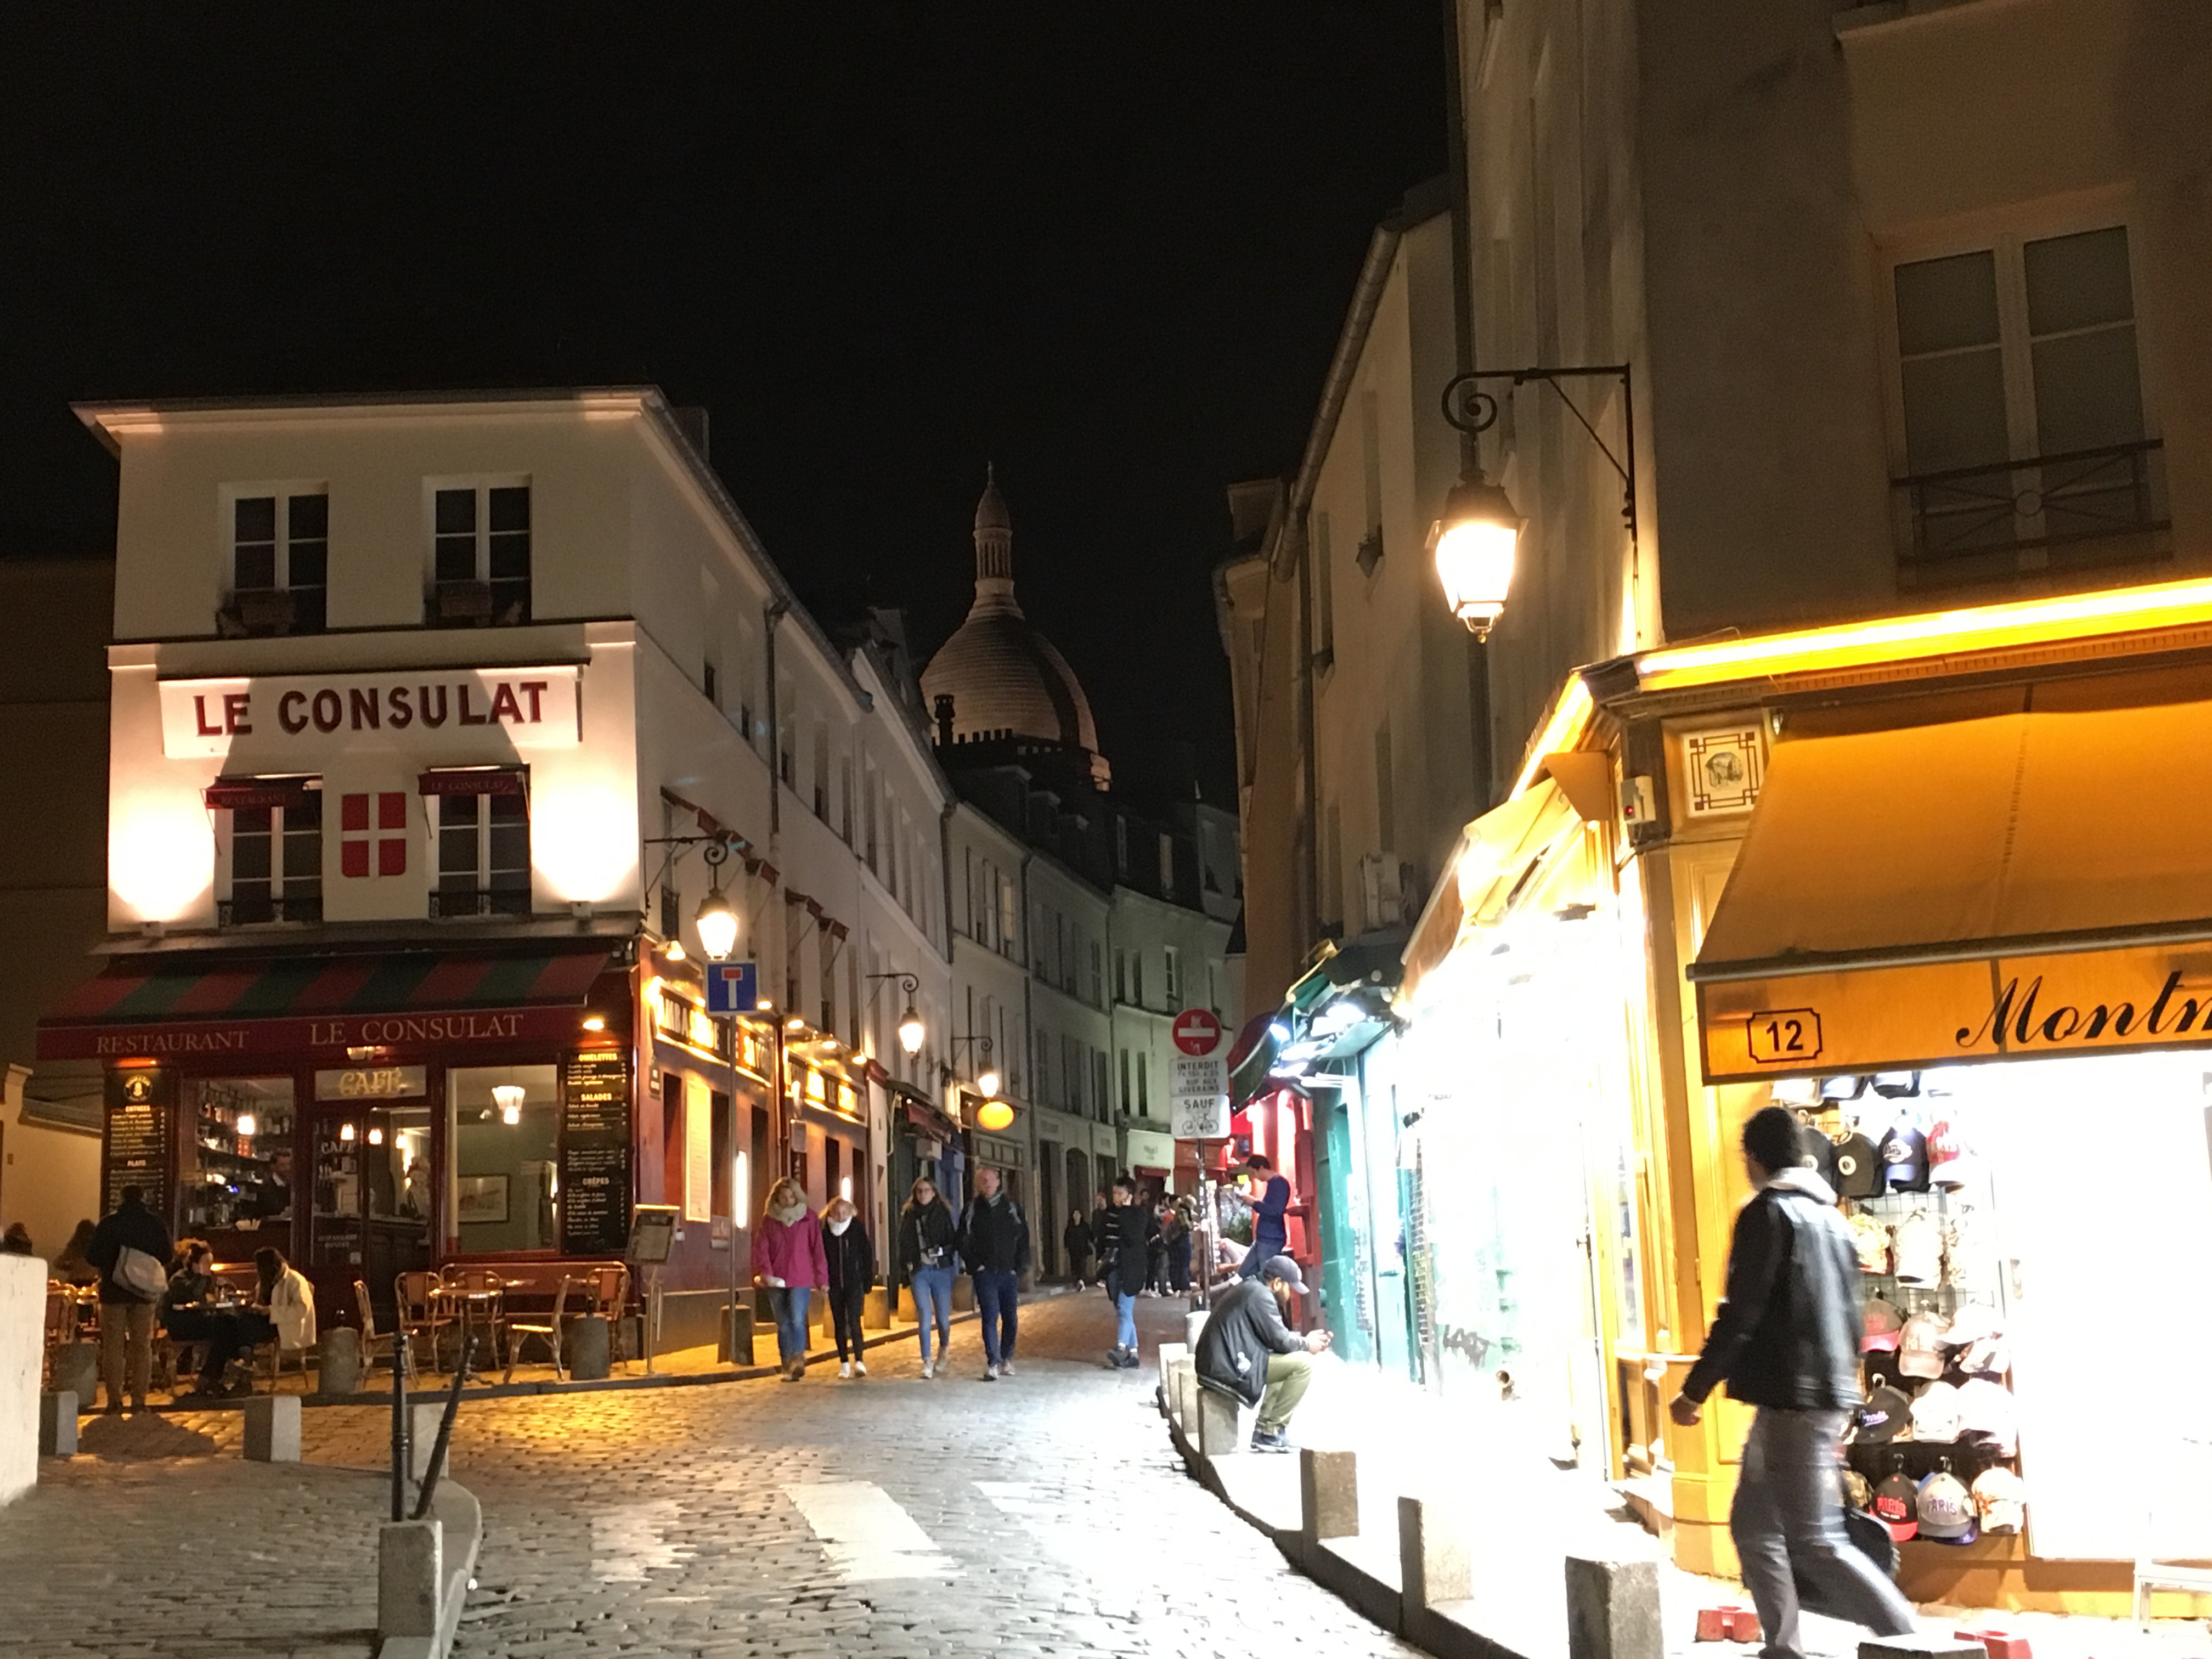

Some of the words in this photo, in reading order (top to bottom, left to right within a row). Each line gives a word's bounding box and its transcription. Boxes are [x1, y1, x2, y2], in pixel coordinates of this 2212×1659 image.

[193, 693, 253, 737] LE
[278, 681, 548, 734] CONSULAT
[221, 793, 286, 804] RESTAURANT
[96, 1029, 249, 1054] RESTAURANT
[310, 1022, 346, 1045] LE
[361, 1013, 524, 1043] CONSULAT
[1765, 1019, 1804, 1053] 12
[578, 1053, 618, 1062] OMELETTES
[1177, 1060, 1218, 1071] INTERDIT
[580, 1093, 612, 1101] SALADES
[1184, 1098, 1215, 1109] SAUF
[1927, 1498, 1957, 1516] PARIS
